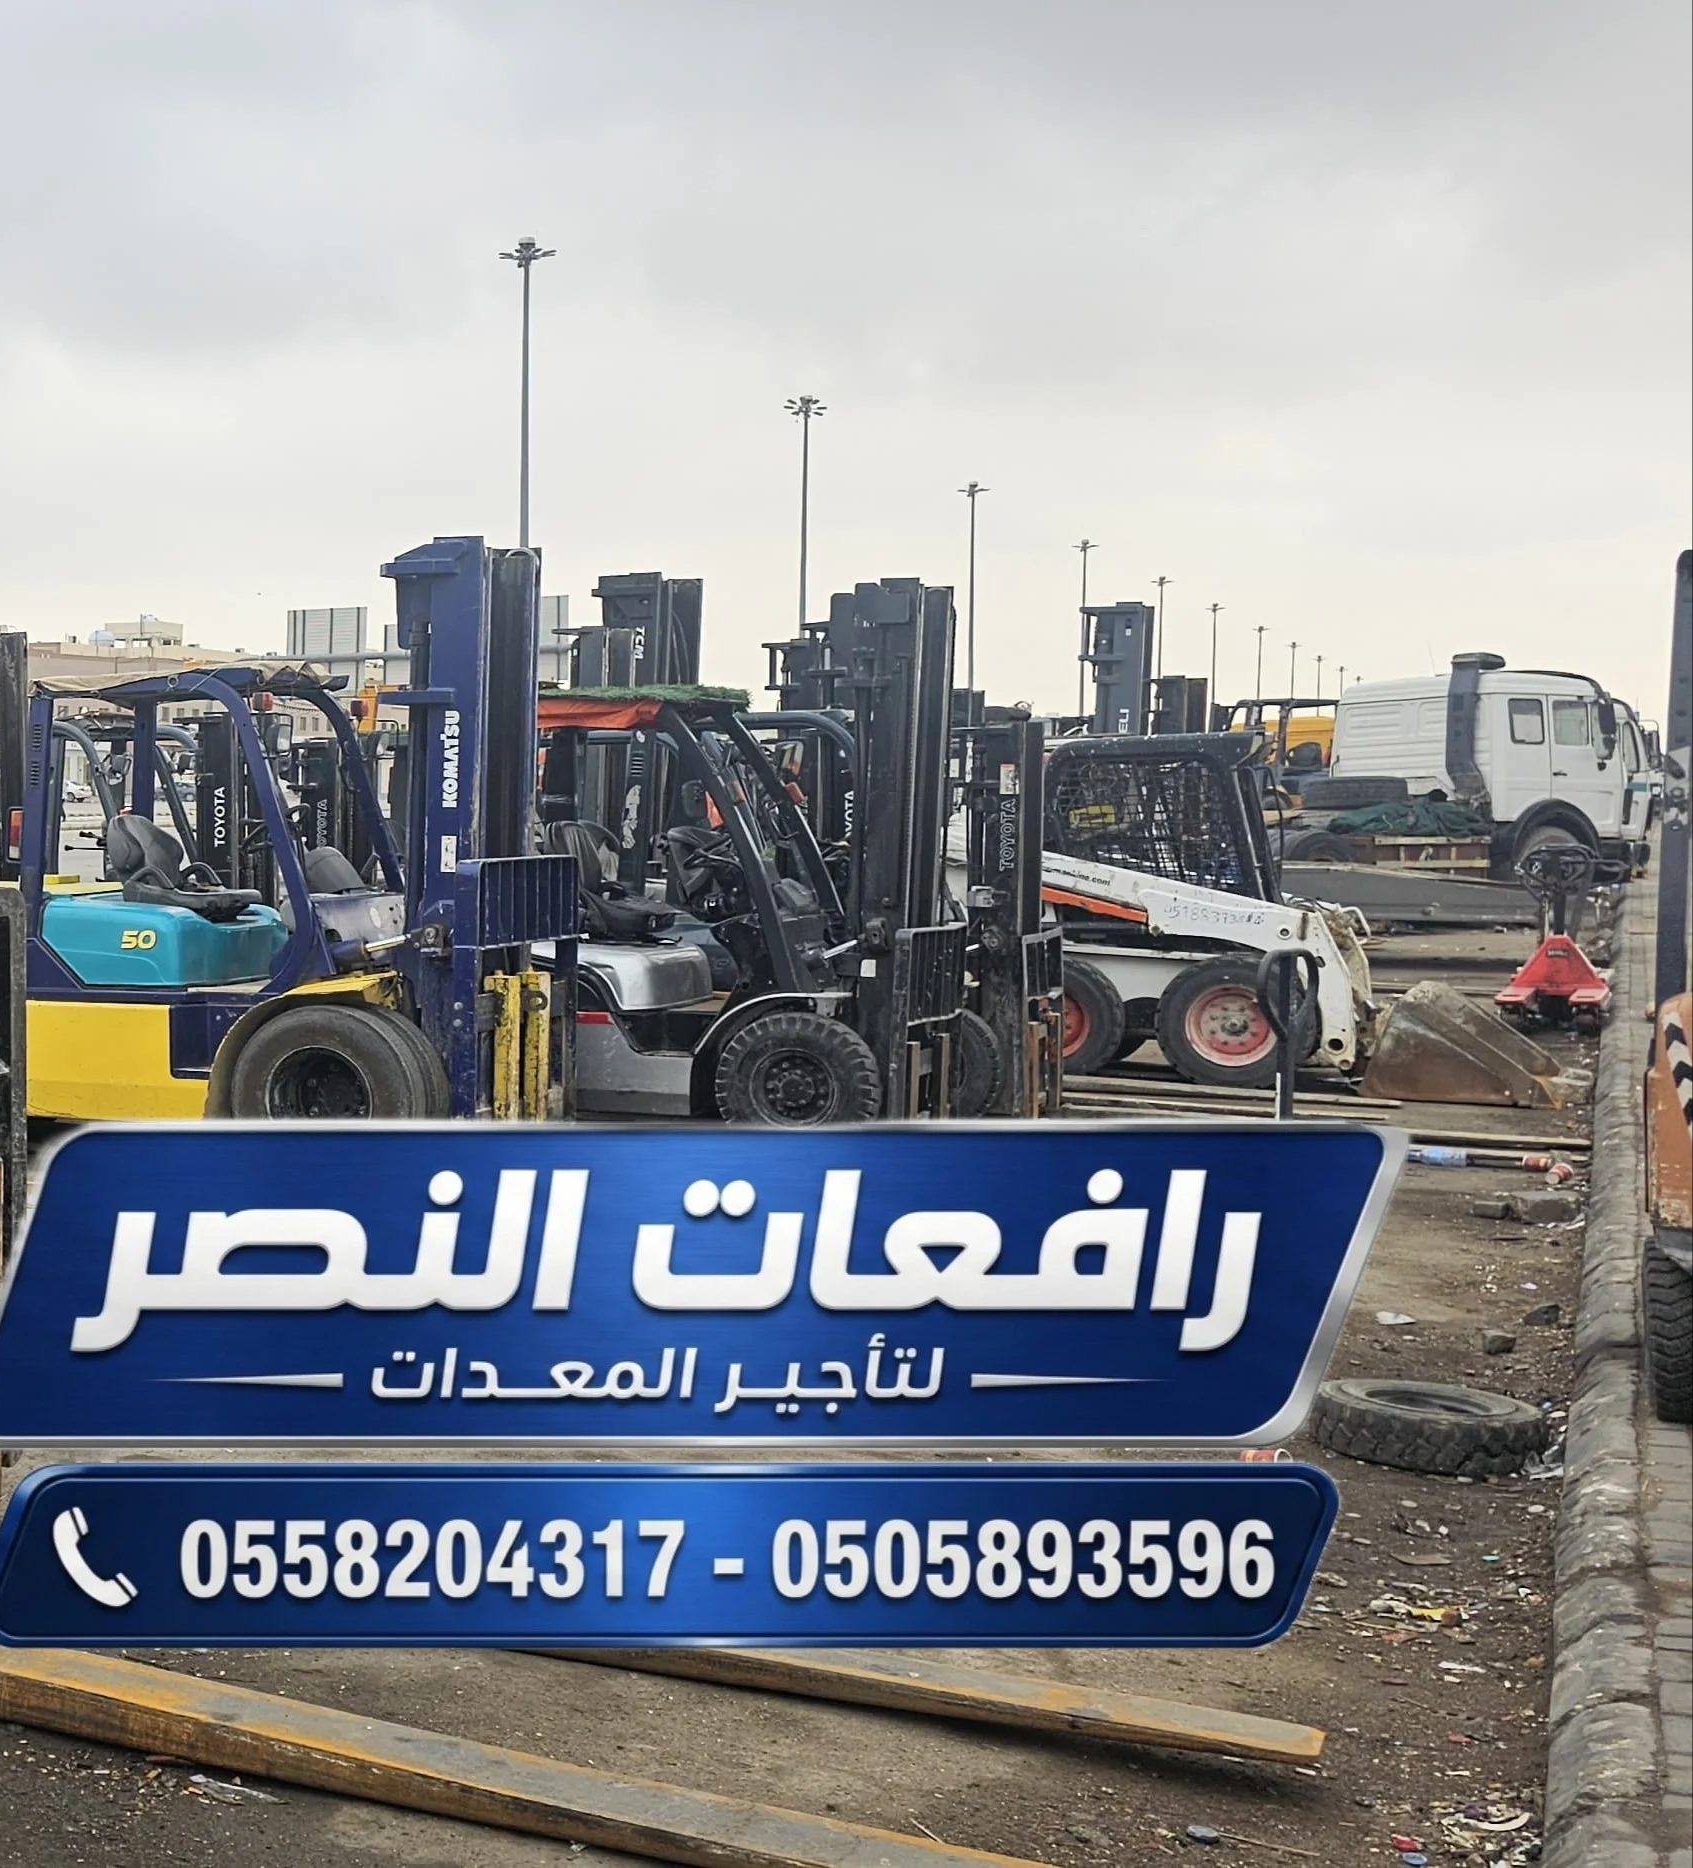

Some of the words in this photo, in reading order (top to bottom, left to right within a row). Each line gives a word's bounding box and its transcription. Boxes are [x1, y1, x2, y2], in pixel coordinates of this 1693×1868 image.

[634, 626, 646, 660] TCM
[1117, 708, 1130, 733] ELI
[440, 710, 460, 808] KOMATSU
[214, 786, 226, 847] TOYOTA
[316, 799, 328, 848] OYOTA
[999, 798, 1016, 872] TOYOTA
[120, 929, 157, 950] 50
